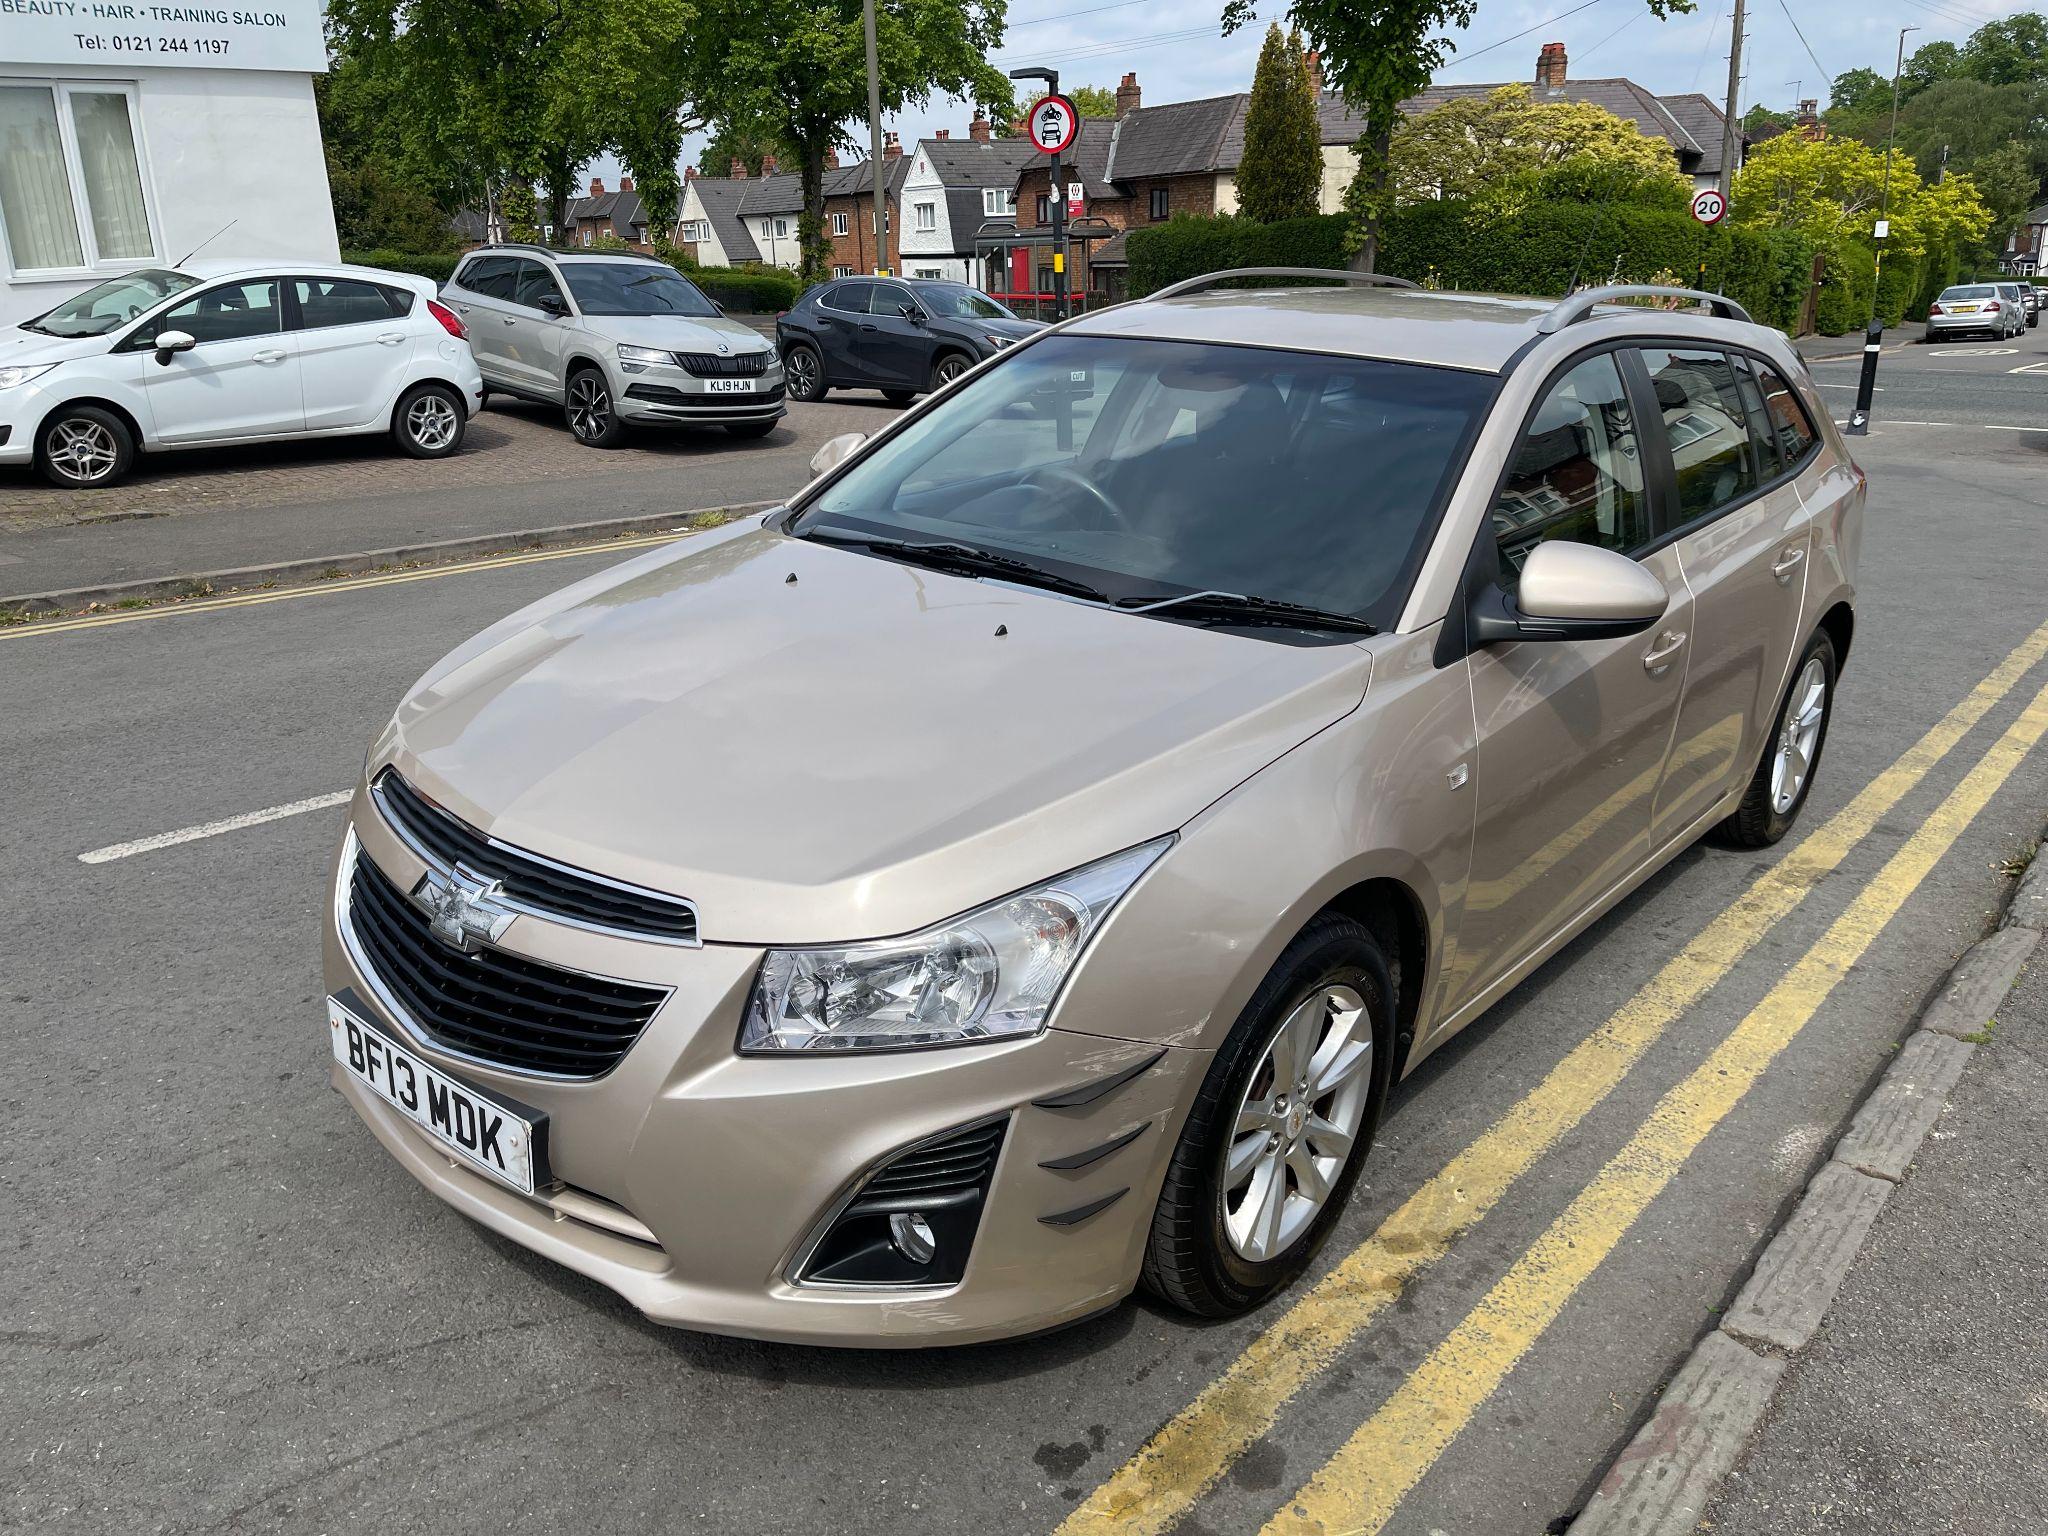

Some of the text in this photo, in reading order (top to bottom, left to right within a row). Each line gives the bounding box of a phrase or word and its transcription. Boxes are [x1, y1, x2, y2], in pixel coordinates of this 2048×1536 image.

[2, 0, 286, 27] BEAUTY HAIR TRAINING SALON
[74, 34, 229, 54] Tel: 0121 244 1197
[1698, 201, 1720, 214] 20
[710, 380, 751, 391] KL19 HJN
[345, 1017, 418, 1111] BF13
[427, 1074, 505, 1171] MDK
